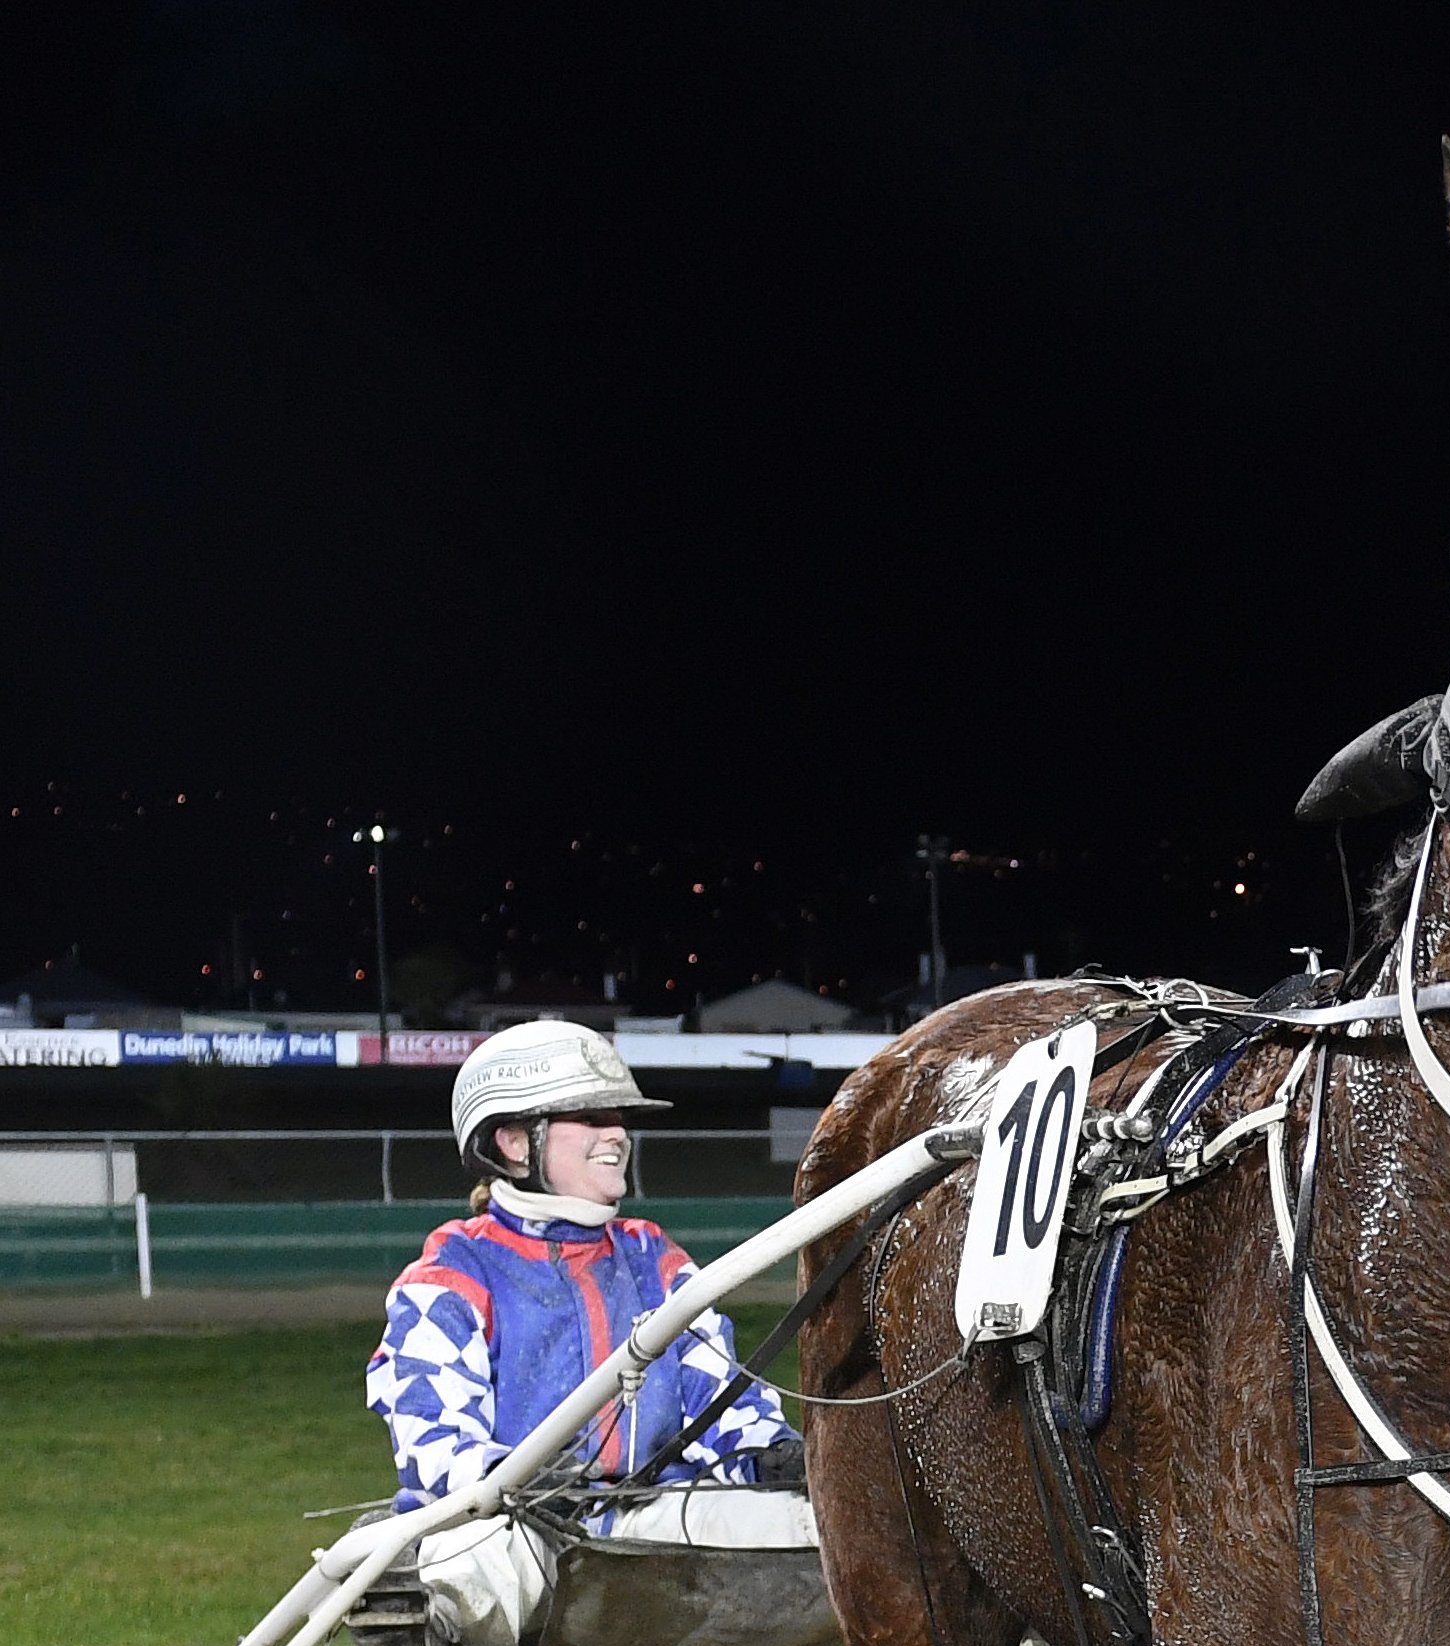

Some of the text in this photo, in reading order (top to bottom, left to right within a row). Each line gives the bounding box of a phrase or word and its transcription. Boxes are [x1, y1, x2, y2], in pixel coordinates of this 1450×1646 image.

[124, 1033, 209, 1056] Dunedin
[212, 1033, 285, 1061] Holiday
[289, 1033, 333, 1056] Park
[389, 1034, 470, 1054] RICOH
[498, 1060, 550, 1079] RACING
[993, 1065, 1075, 1257] 10
